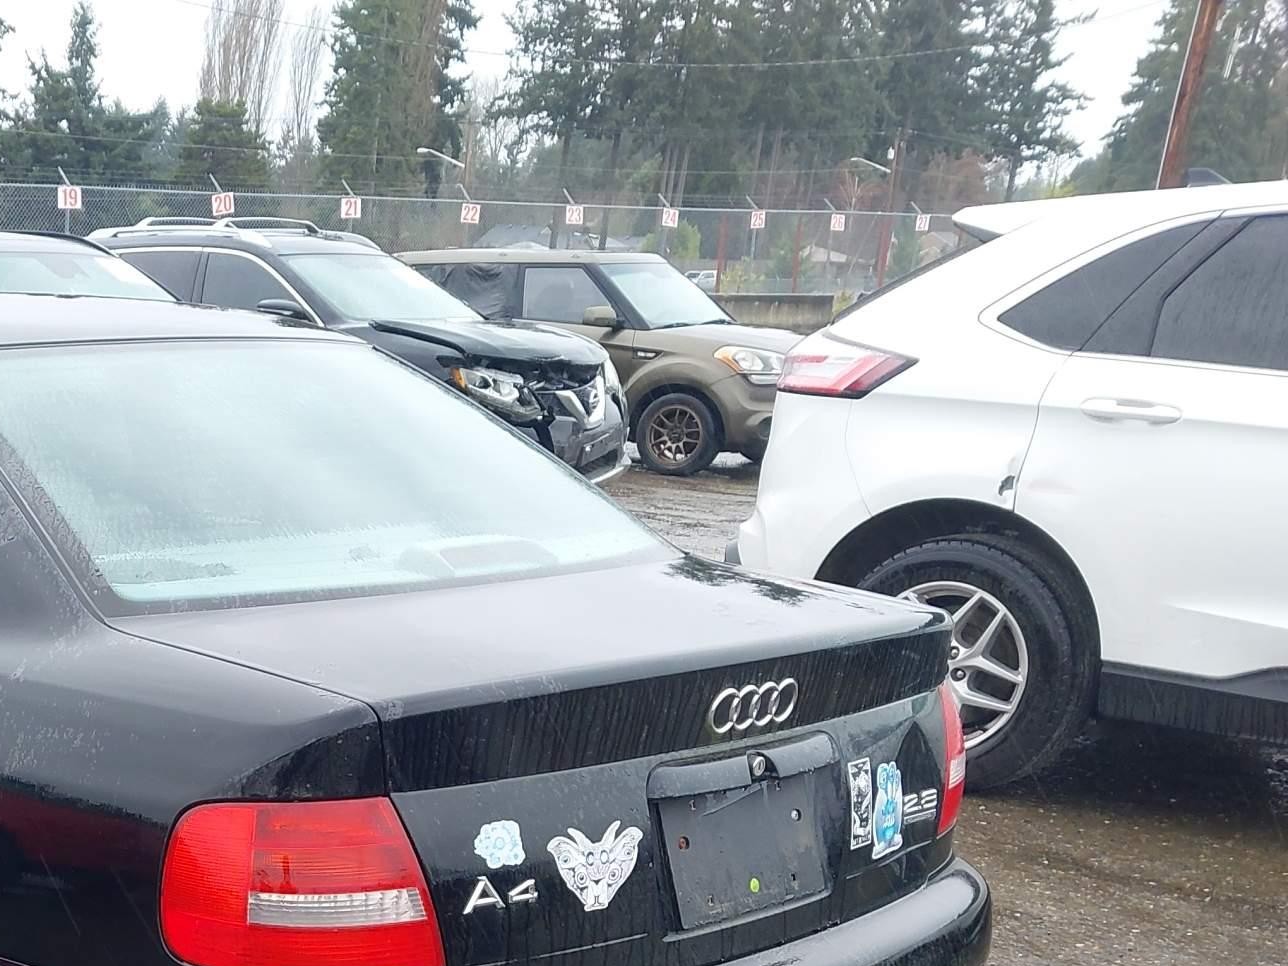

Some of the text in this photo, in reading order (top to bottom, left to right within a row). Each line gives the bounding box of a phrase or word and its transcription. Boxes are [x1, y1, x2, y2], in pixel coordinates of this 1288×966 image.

[61, 188, 78, 207] 19
[214, 194, 232, 214] 20
[344, 199, 358, 217] 21
[462, 204, 478, 221] 22
[567, 206, 582, 223] 23
[664, 210, 677, 226] 24
[752, 211, 764, 227] 25
[832, 215, 844, 230] 26
[918, 215, 929, 230] 27
[463, 876, 538, 914] A4
